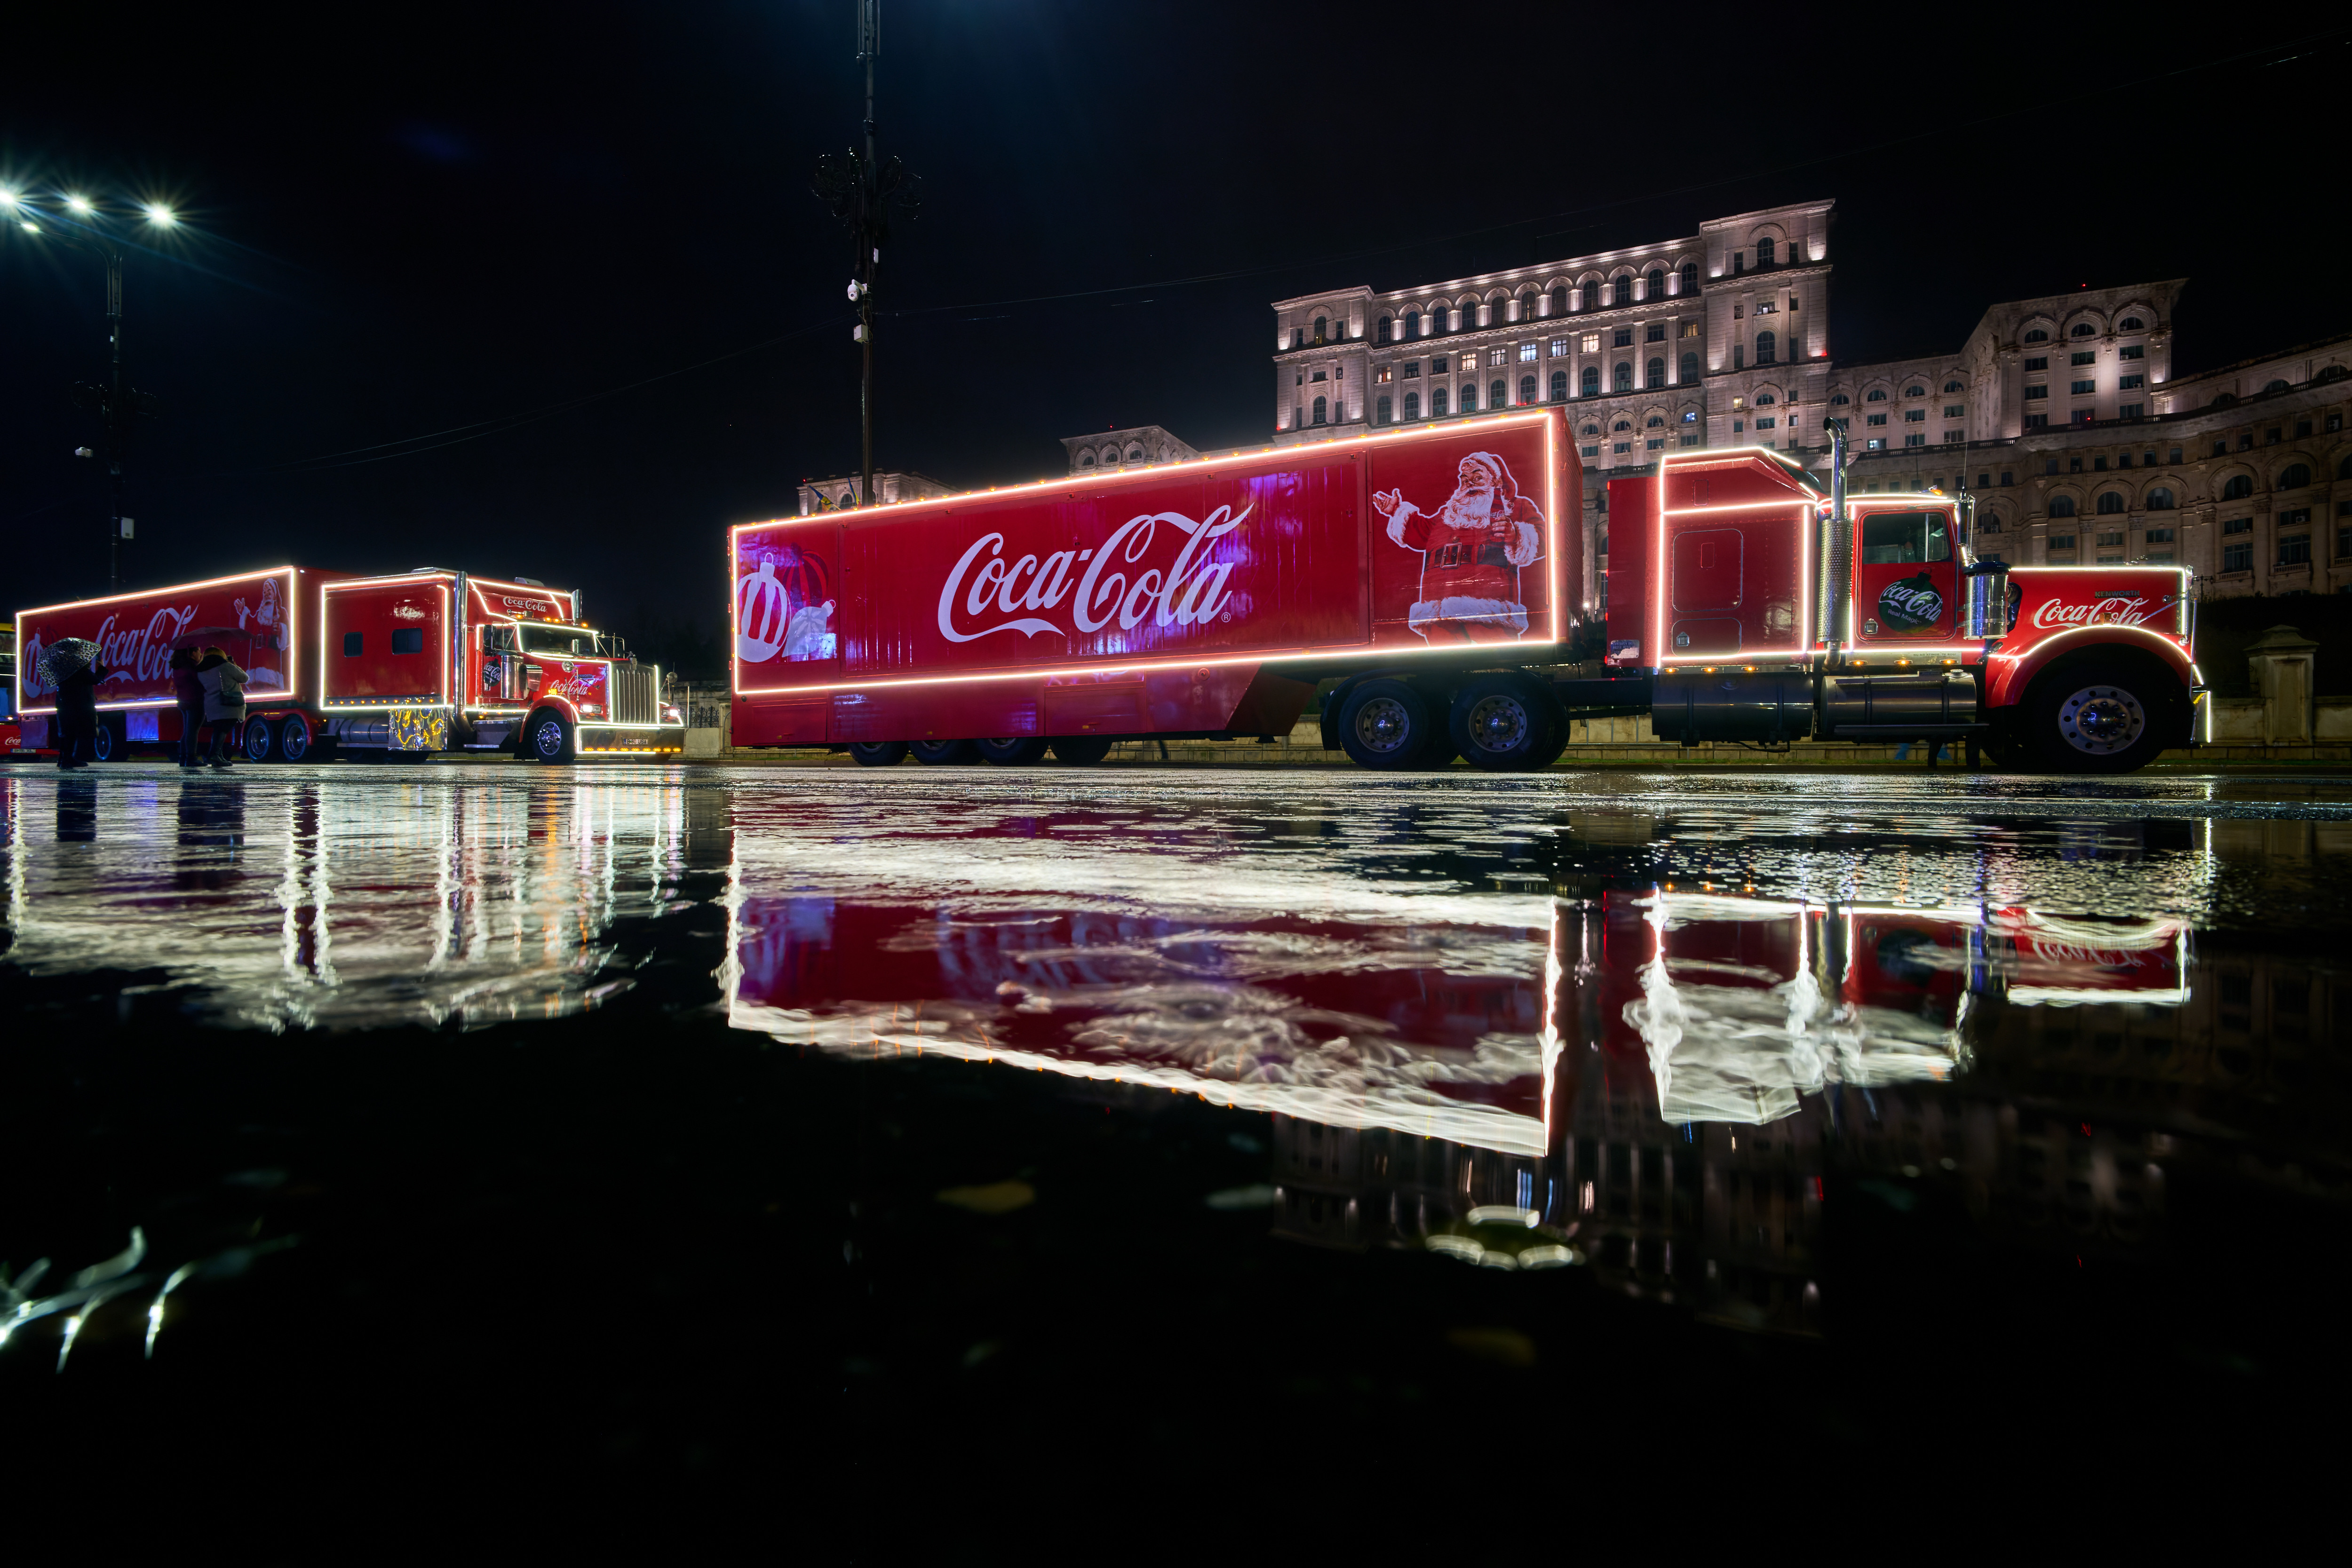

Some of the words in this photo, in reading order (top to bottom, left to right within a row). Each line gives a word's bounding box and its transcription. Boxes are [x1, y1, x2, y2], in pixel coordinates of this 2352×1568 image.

[938, 502, 1255, 643] Coca-Cola
[503, 597, 548, 613] Coca-Cola
[1879, 581, 1943, 621] Coca-Cola
[2034, 598, 2149, 629] Coca-Cola
[1901, 613, 1920, 624] Magic
